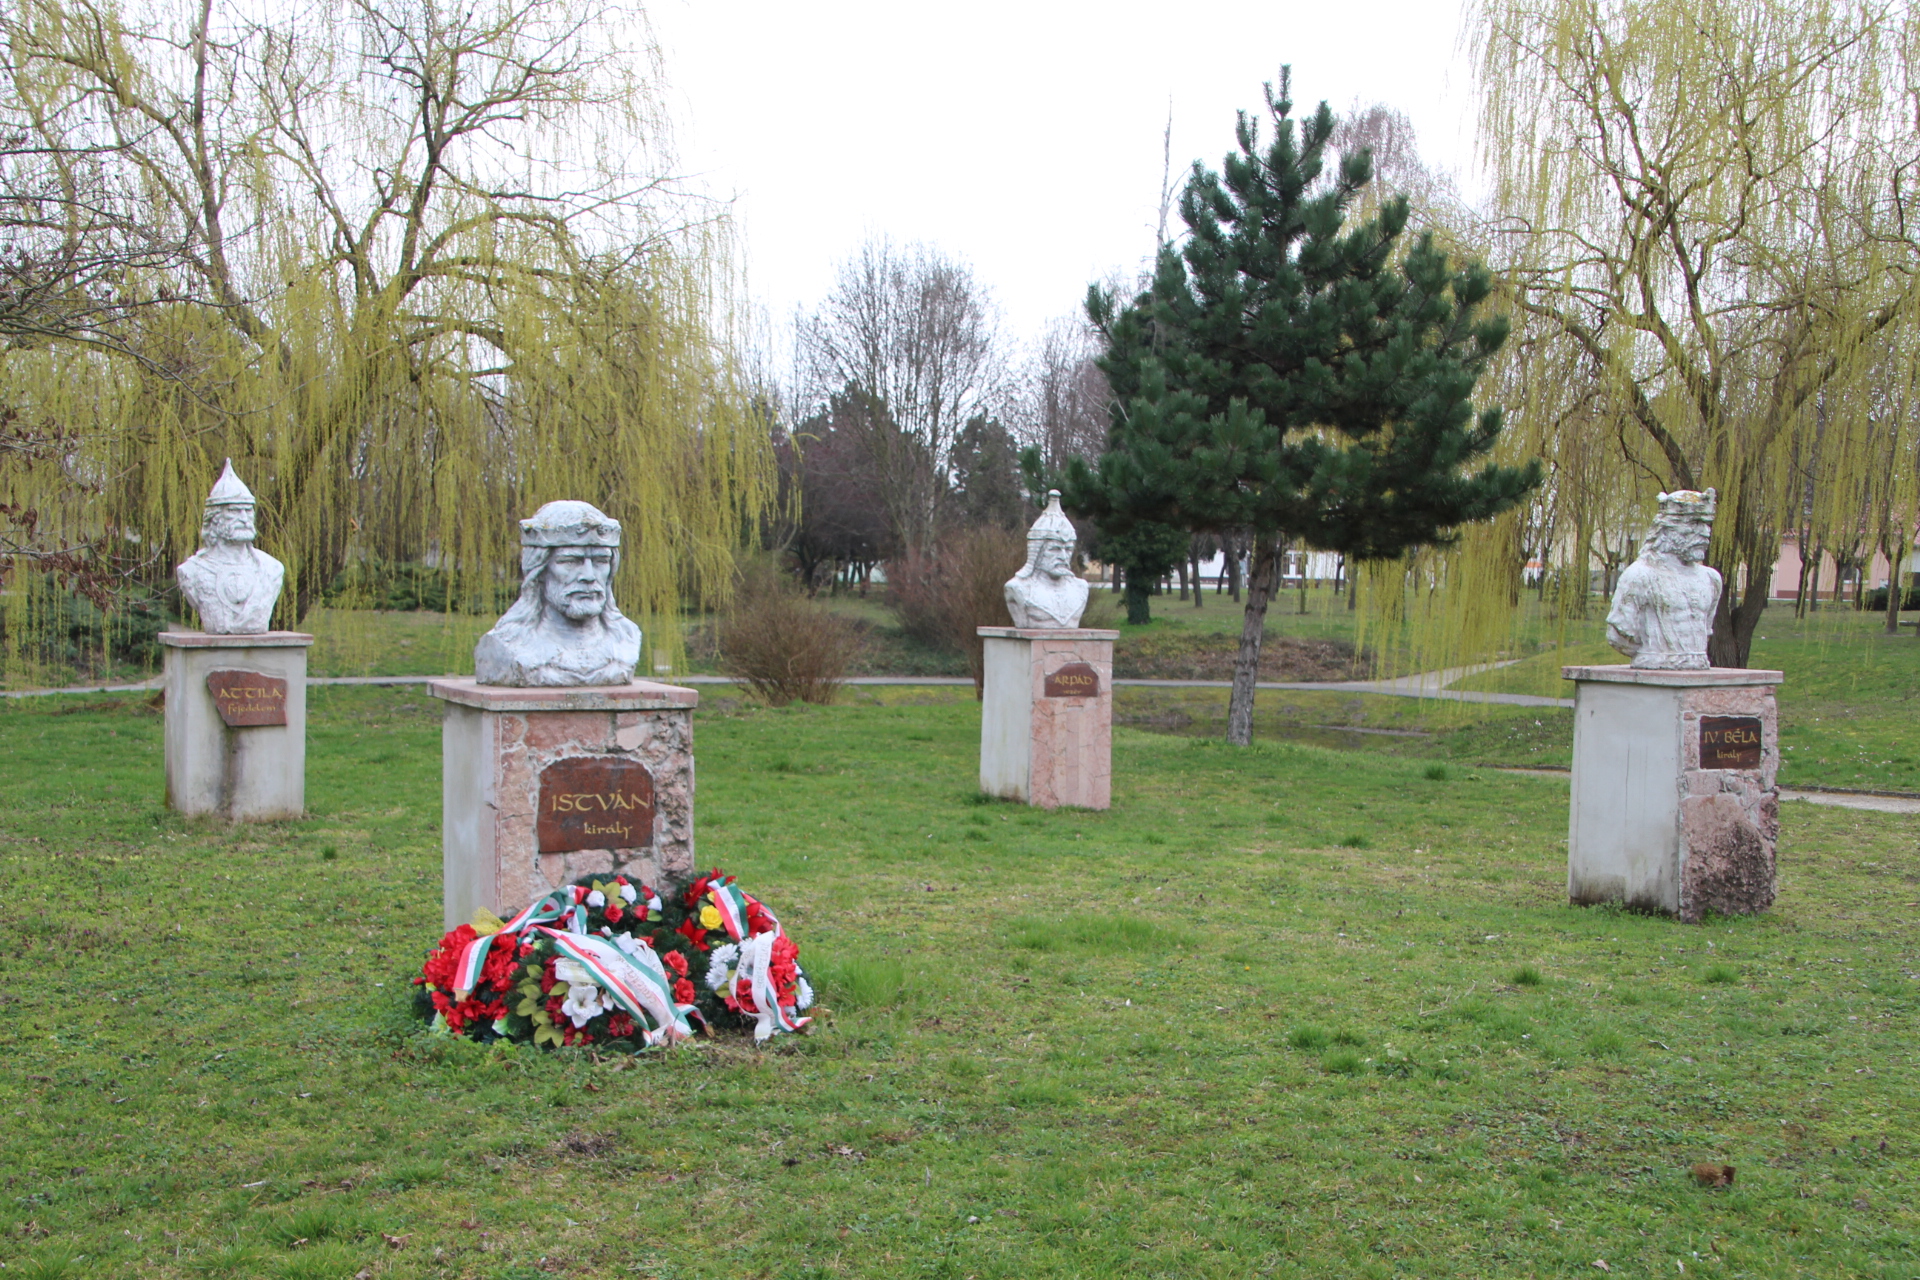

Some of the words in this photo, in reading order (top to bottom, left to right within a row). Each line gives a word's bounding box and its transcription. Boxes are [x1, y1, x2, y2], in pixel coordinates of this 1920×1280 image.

[219, 687, 283, 699] ATTILA
[227, 703, 276, 715] fejedelem
[1704, 731, 1720, 744] IV.
[1724, 728, 1758, 744] BÉLA
[1716, 749, 1742, 763] király
[551, 788, 651, 812] ISTVÁN
[583, 821, 633, 840] király
